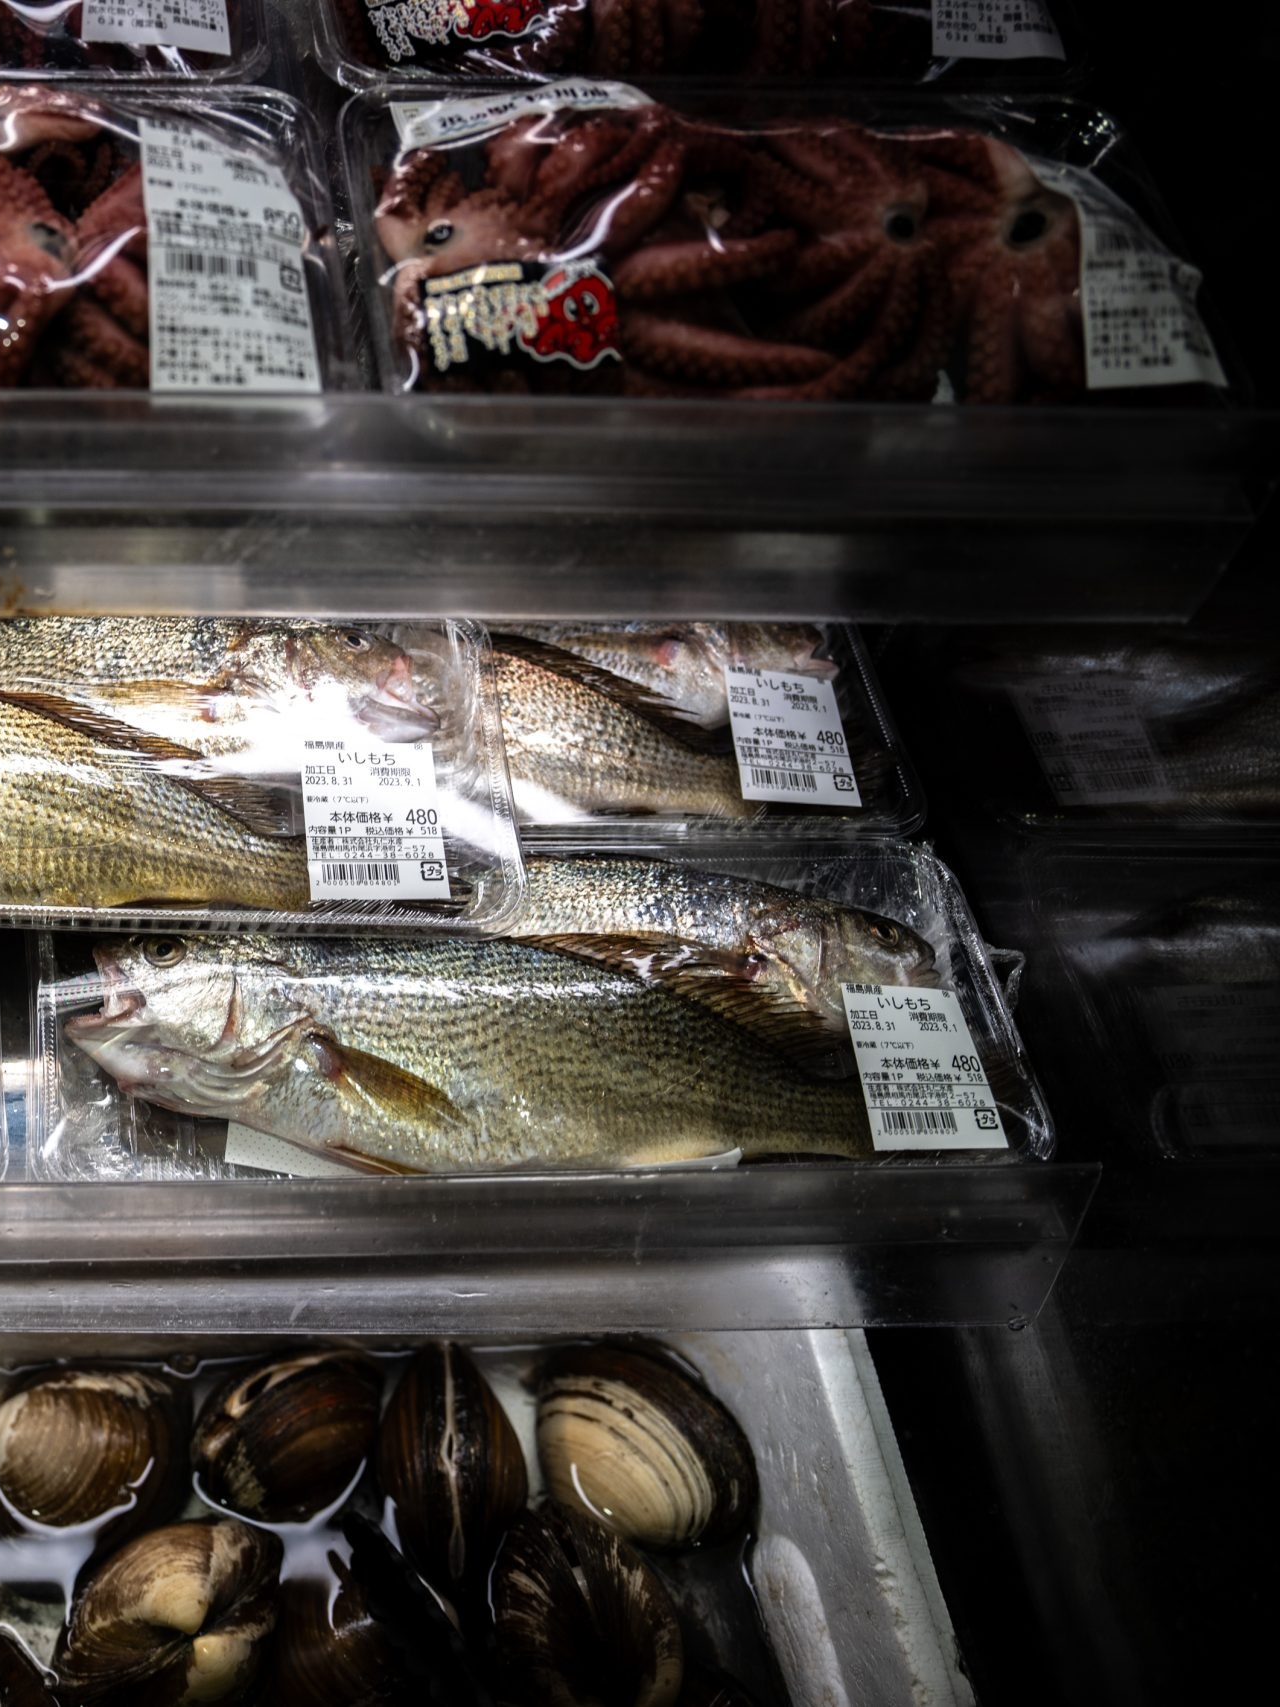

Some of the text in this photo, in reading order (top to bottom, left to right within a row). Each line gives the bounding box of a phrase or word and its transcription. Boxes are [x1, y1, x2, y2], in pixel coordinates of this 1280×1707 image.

[338, 752, 396, 765] いしもち
[305, 766, 411, 777] 加工日 消費期限
[330, 809, 438, 825] 本体価格¥ 480
[421, 827, 437, 835] 518
[878, 997, 931, 1011] いしもち
[850, 1010, 878, 1019] 加工日
[952, 1055, 981, 1072] 480
[968, 1073, 983, 1082] 518
